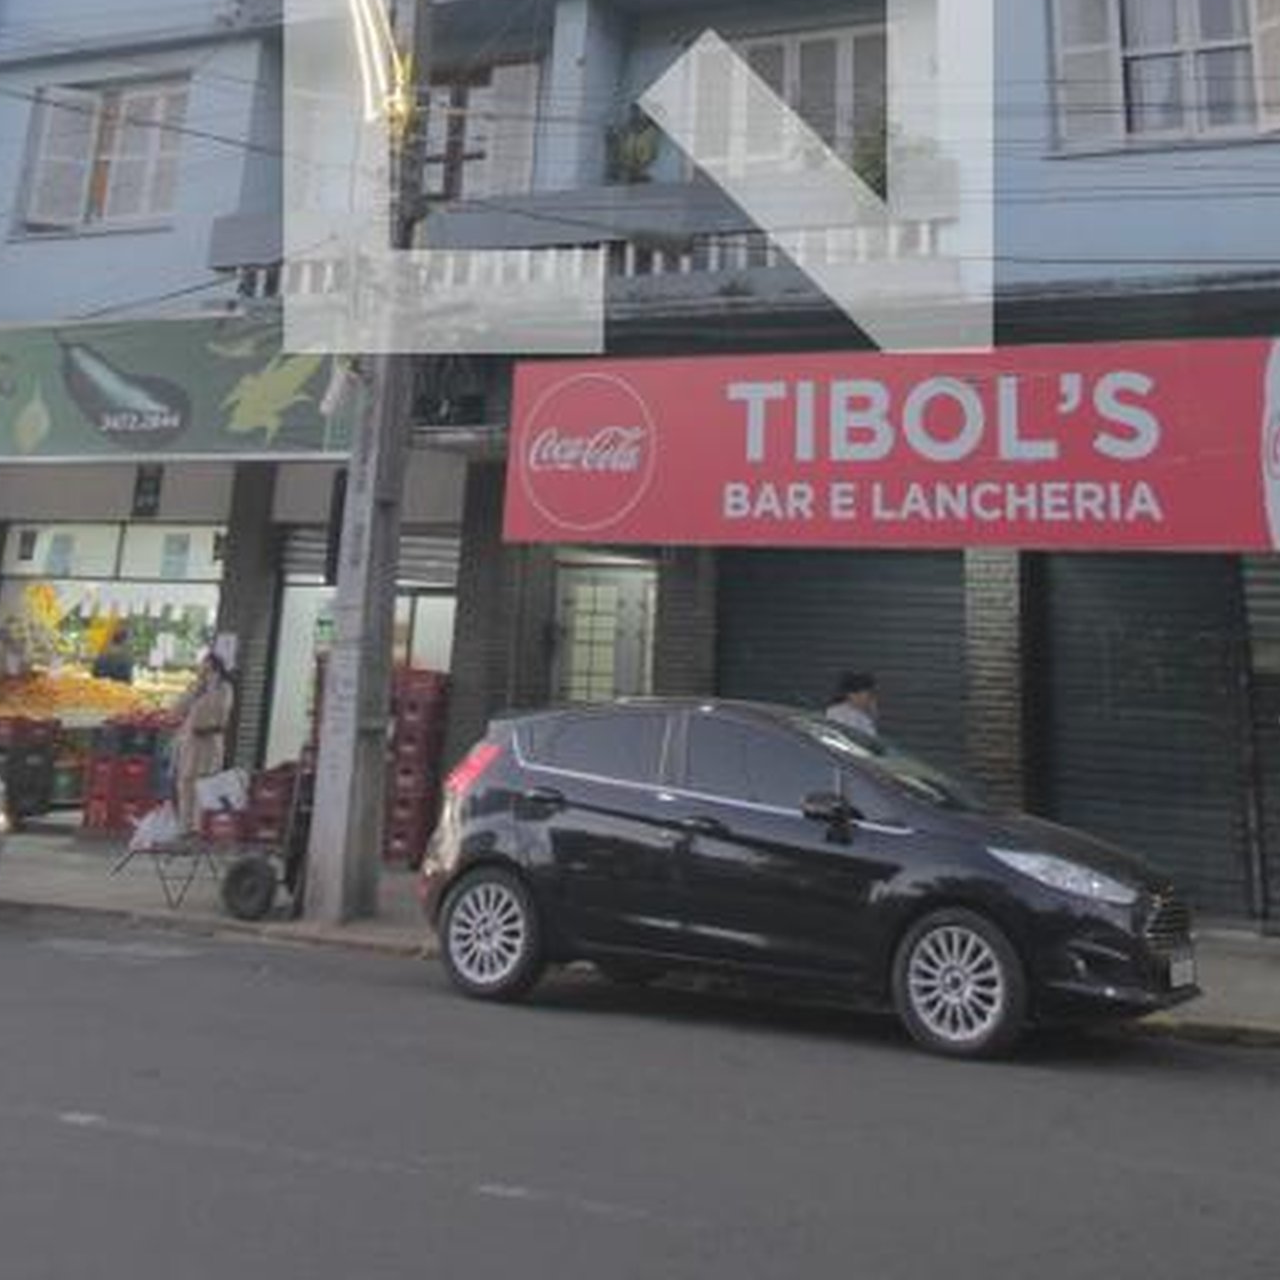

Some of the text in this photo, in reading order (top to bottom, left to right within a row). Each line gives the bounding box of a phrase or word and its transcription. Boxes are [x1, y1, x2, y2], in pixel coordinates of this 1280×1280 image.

[727, 371, 1161, 462] TIBOL'S
[529, 425, 645, 472] Coca-Cola
[724, 481, 1163, 522] BAR E LANCHERIA
